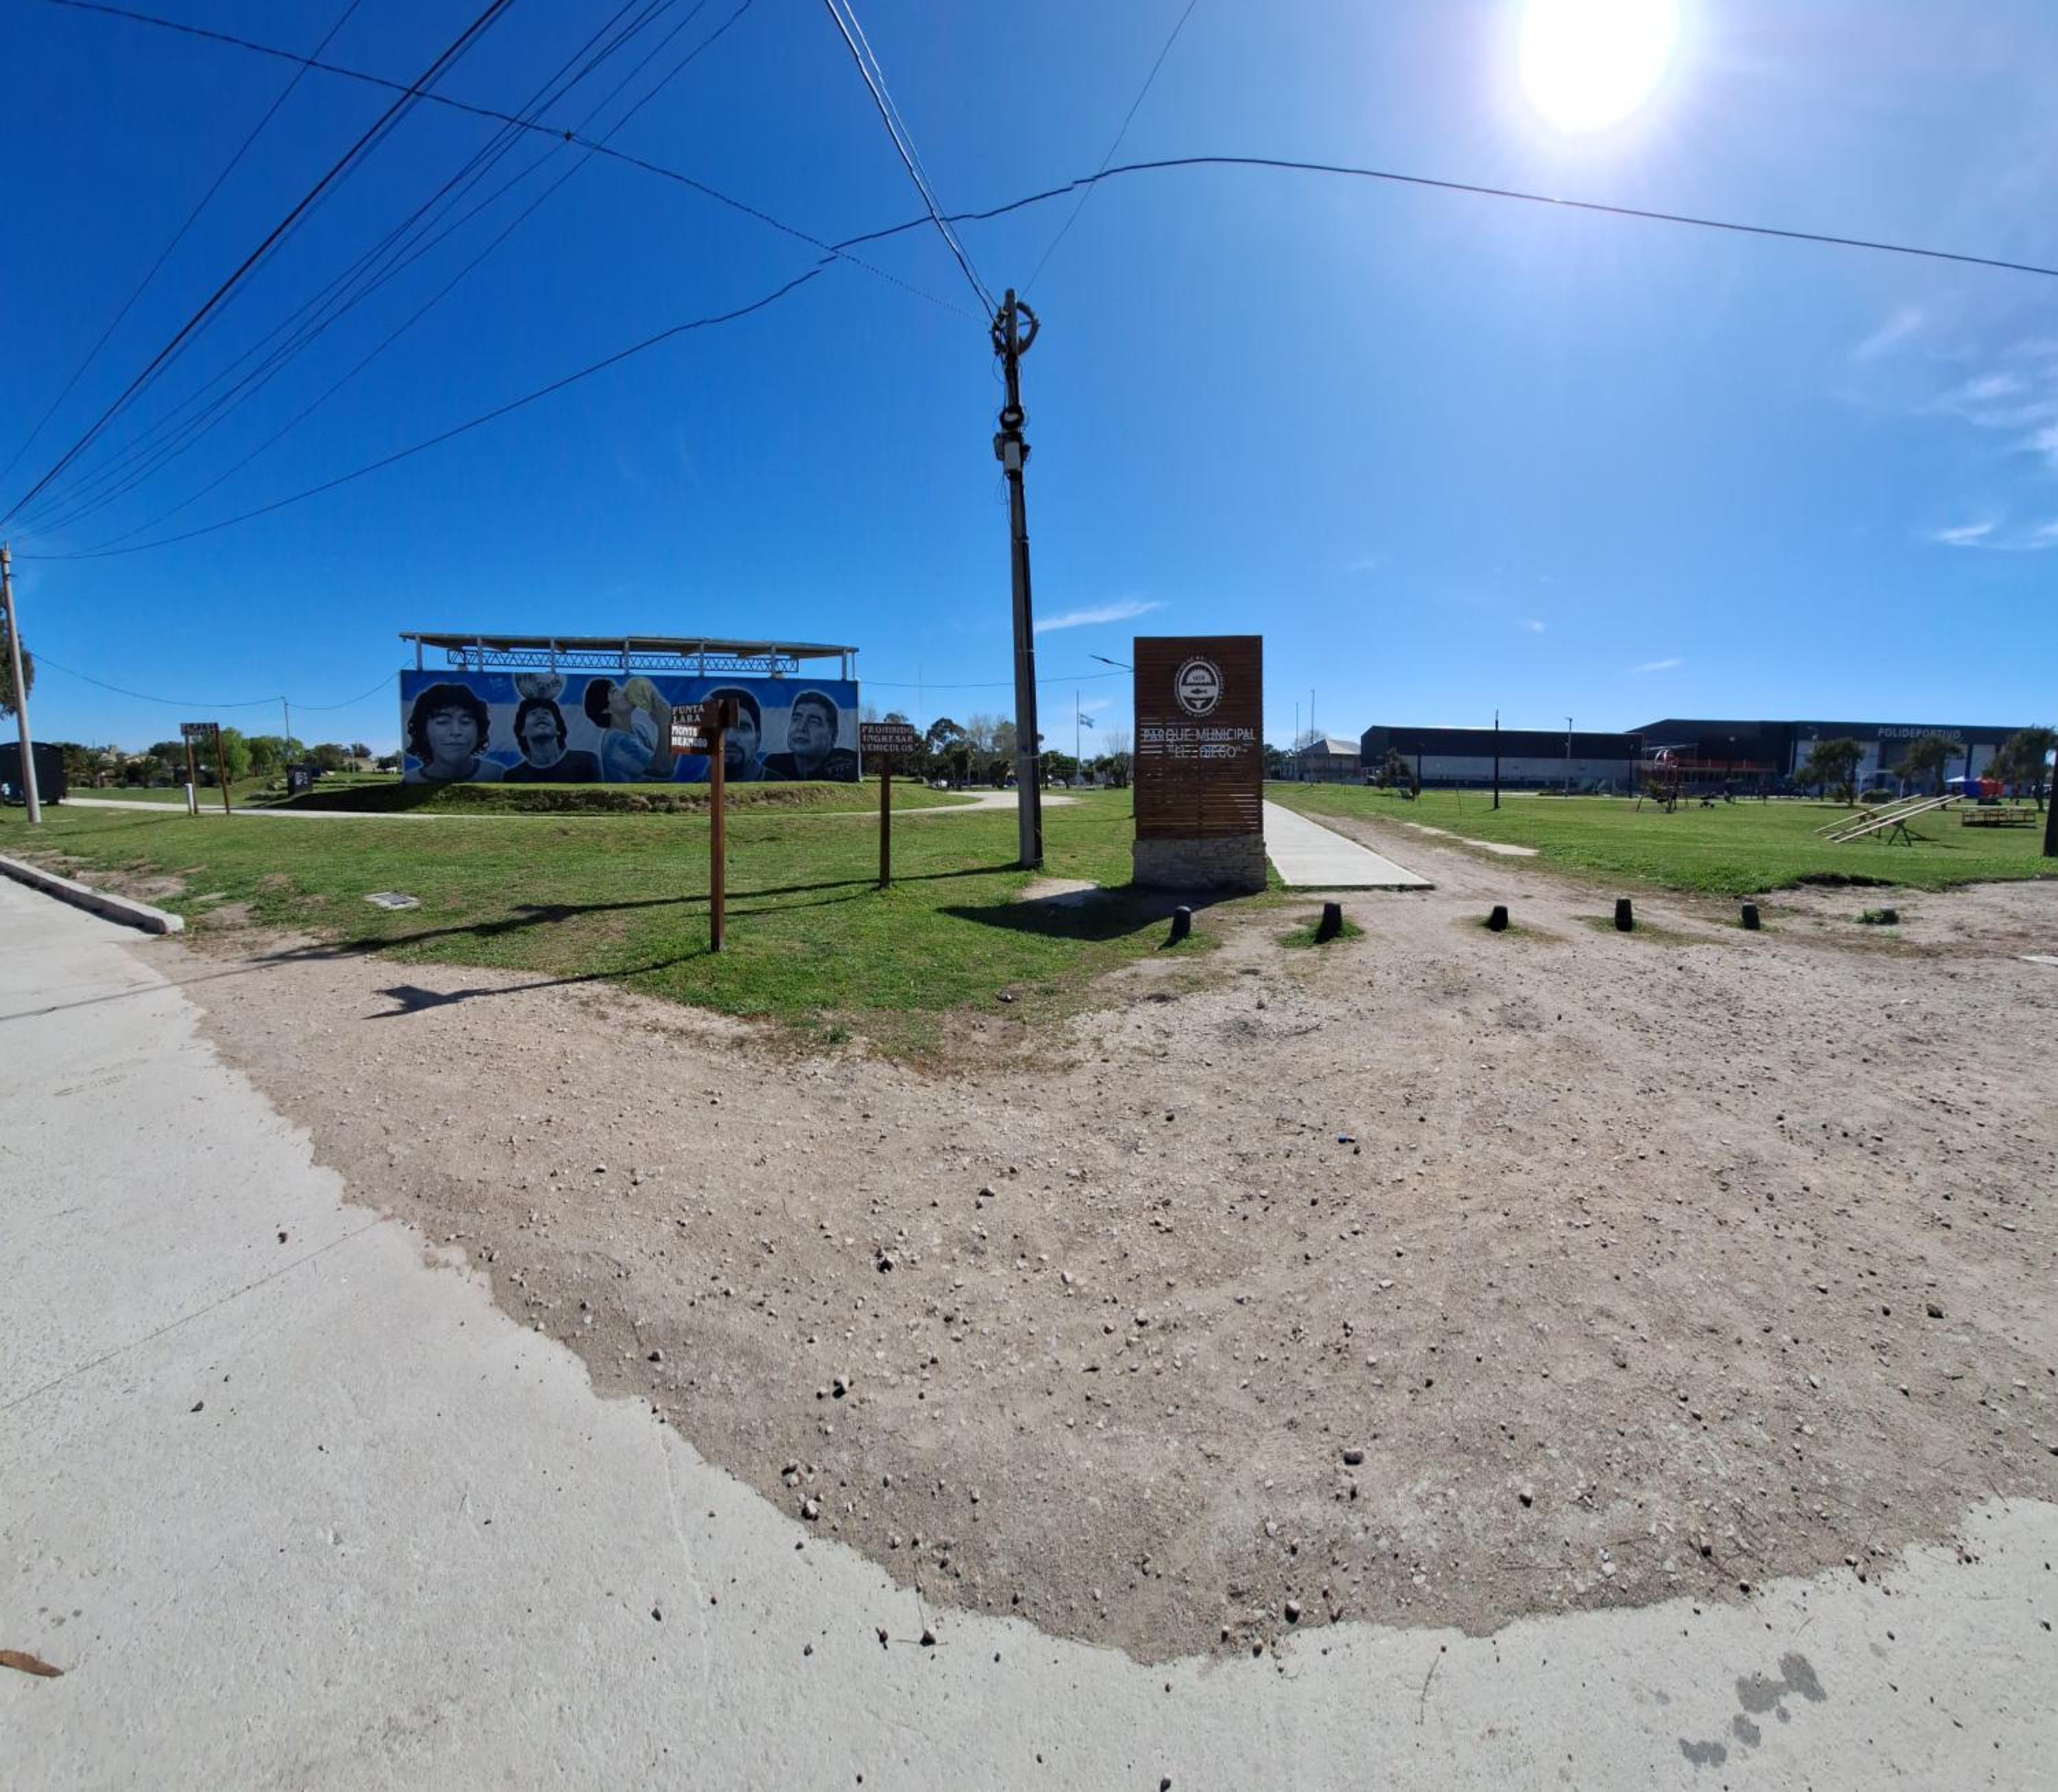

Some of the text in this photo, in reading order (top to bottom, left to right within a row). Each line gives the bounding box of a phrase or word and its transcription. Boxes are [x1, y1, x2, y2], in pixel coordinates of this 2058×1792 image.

[672, 705, 705, 715] PUNTA
[672, 714, 701, 724] LARA
[1142, 727, 1256, 743] PARQUE MUNICIPAL
[1878, 727, 1962, 739] POLIDEPORTIVO
